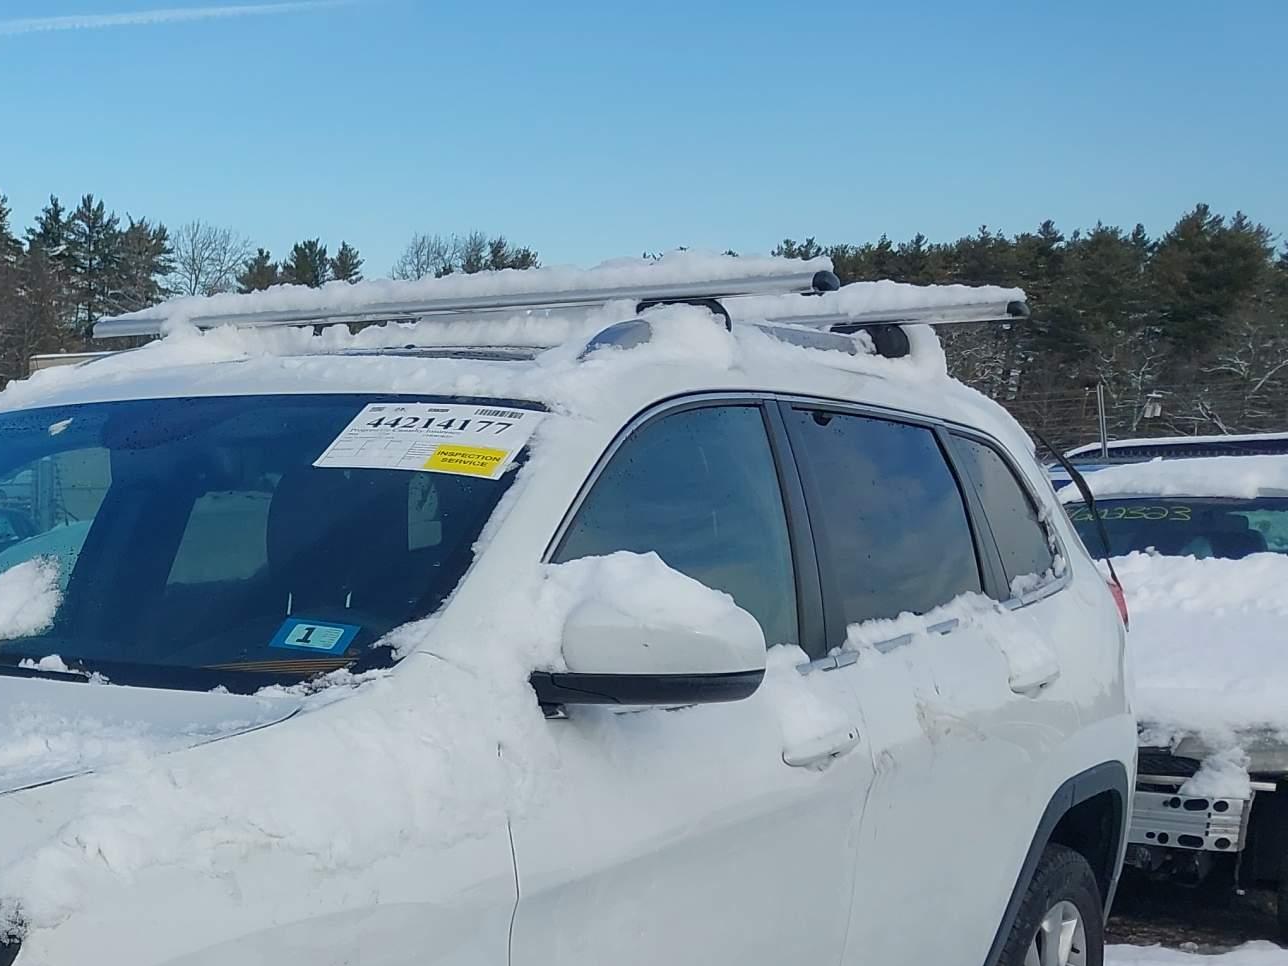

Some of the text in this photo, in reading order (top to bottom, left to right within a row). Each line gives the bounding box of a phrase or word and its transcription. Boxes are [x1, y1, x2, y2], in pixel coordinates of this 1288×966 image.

[366, 416, 513, 434] 44214177
[437, 450, 501, 463] INSPECTION
[440, 457, 489, 468] SERVICE
[295, 627, 316, 643] 1
